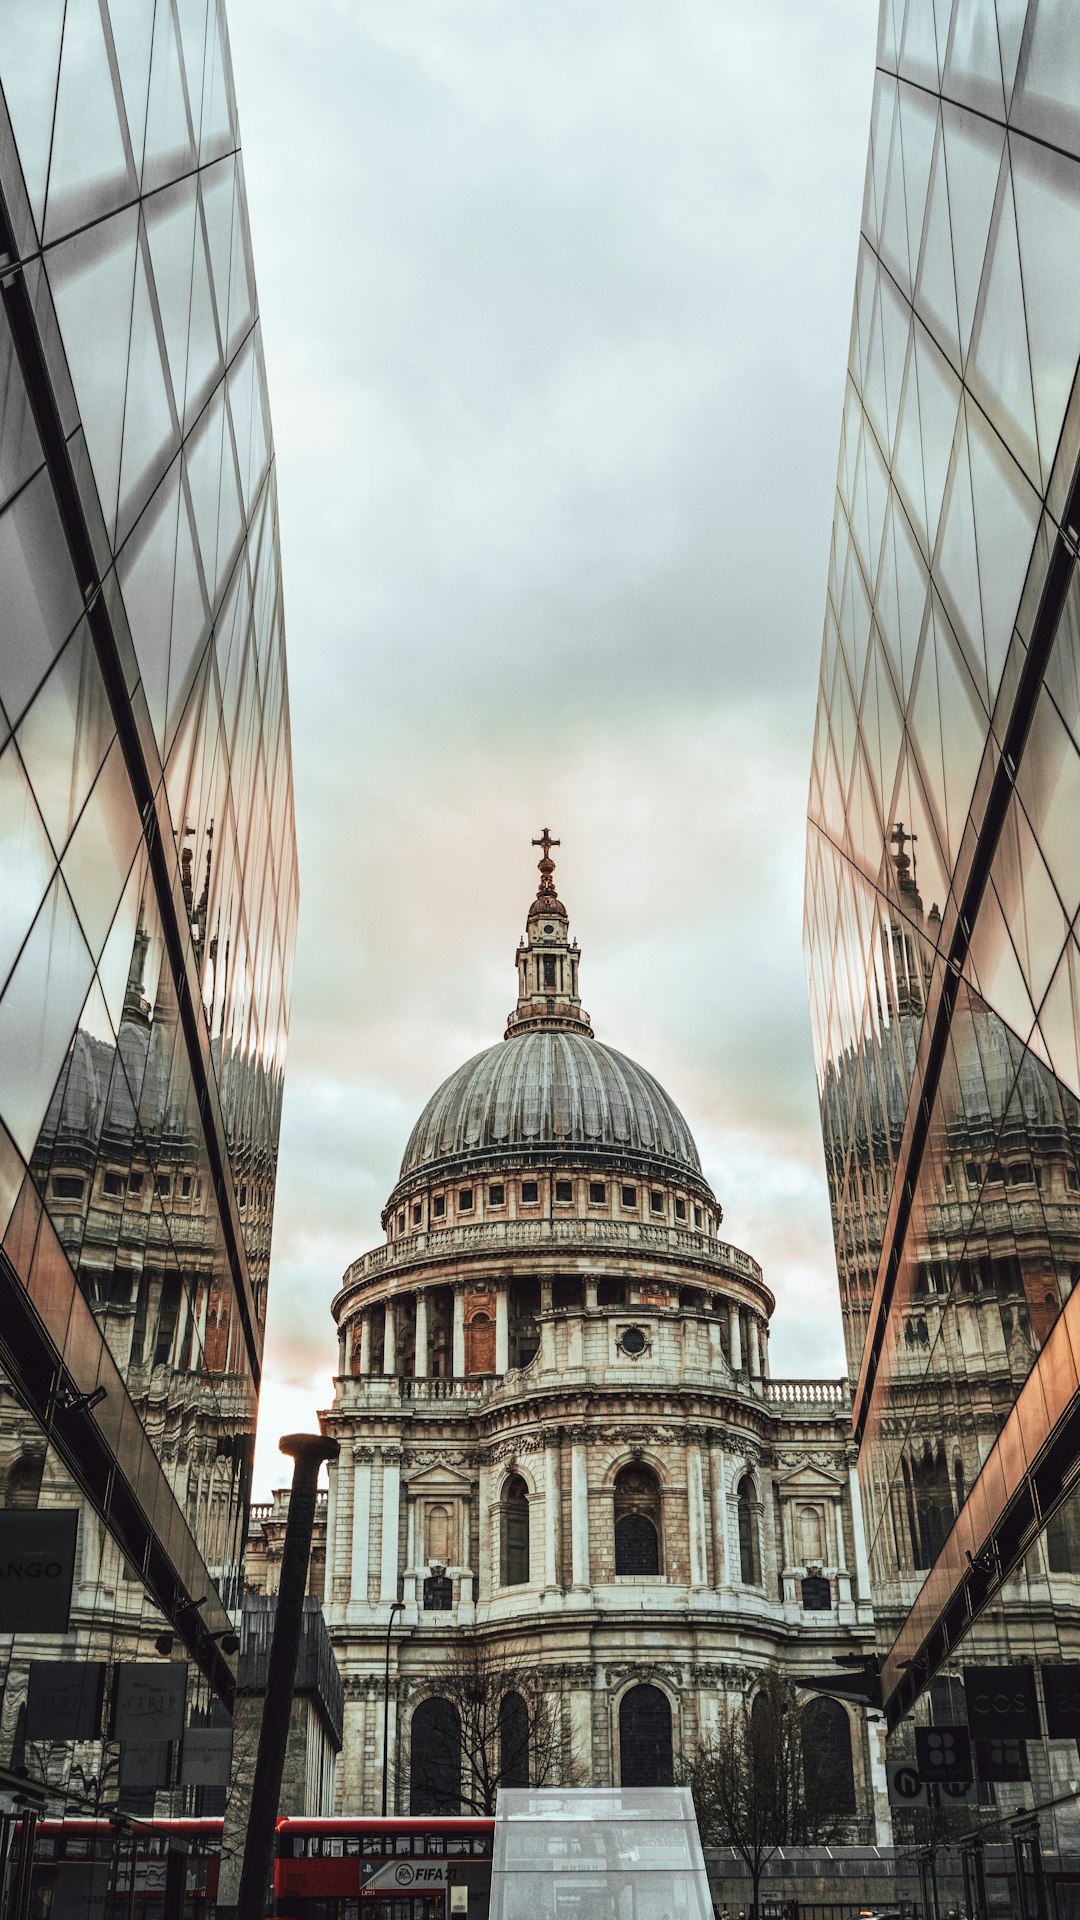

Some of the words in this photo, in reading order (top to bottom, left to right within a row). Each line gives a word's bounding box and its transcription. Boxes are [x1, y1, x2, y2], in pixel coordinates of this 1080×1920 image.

[121, 1696, 176, 1713] STRIP
[974, 1694, 1026, 1713] COS
[415, 1868, 443, 1881] FIFA
[444, 1868, 457, 1881] 21
